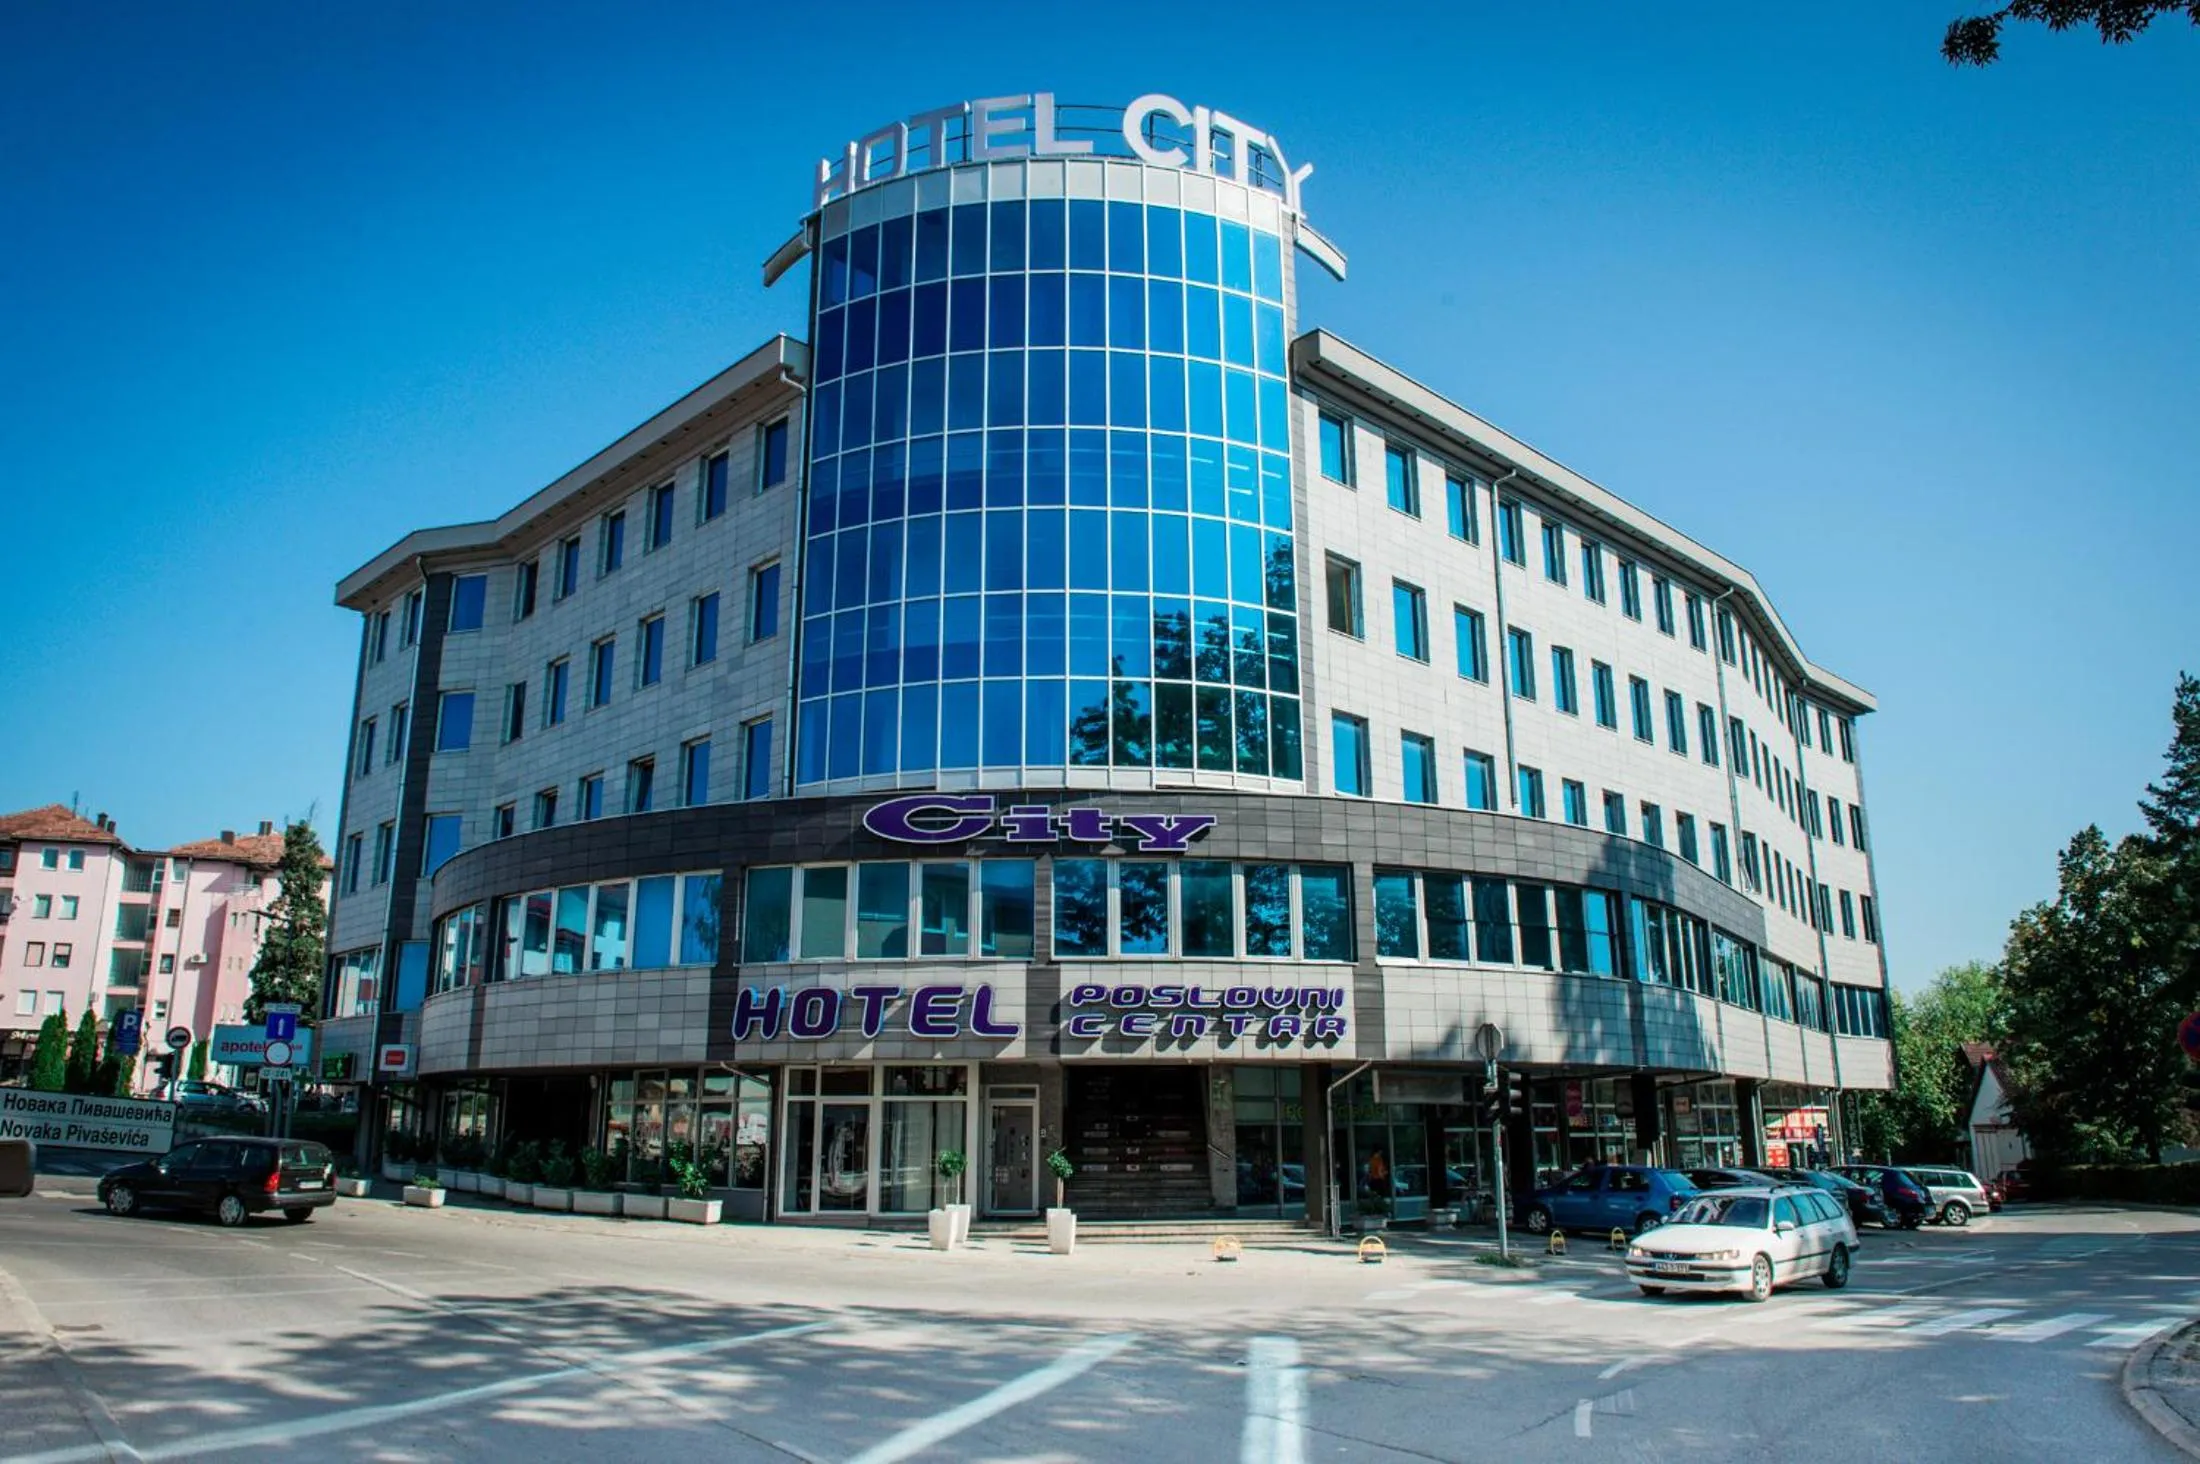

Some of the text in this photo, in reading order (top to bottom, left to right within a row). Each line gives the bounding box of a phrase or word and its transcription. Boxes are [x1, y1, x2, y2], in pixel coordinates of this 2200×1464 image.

[812, 92, 1314, 211] HOTEL CITY
[863, 794, 1217, 852] City
[731, 983, 1021, 1039] HOTEL
[1069, 983, 1345, 1009] POSLOVNI
[1069, 1012, 1348, 1039] CENTAR
[3, 1092, 173, 1123] Новака Пивашевића
[0, 1119, 150, 1147] Novaka Pivaševića
